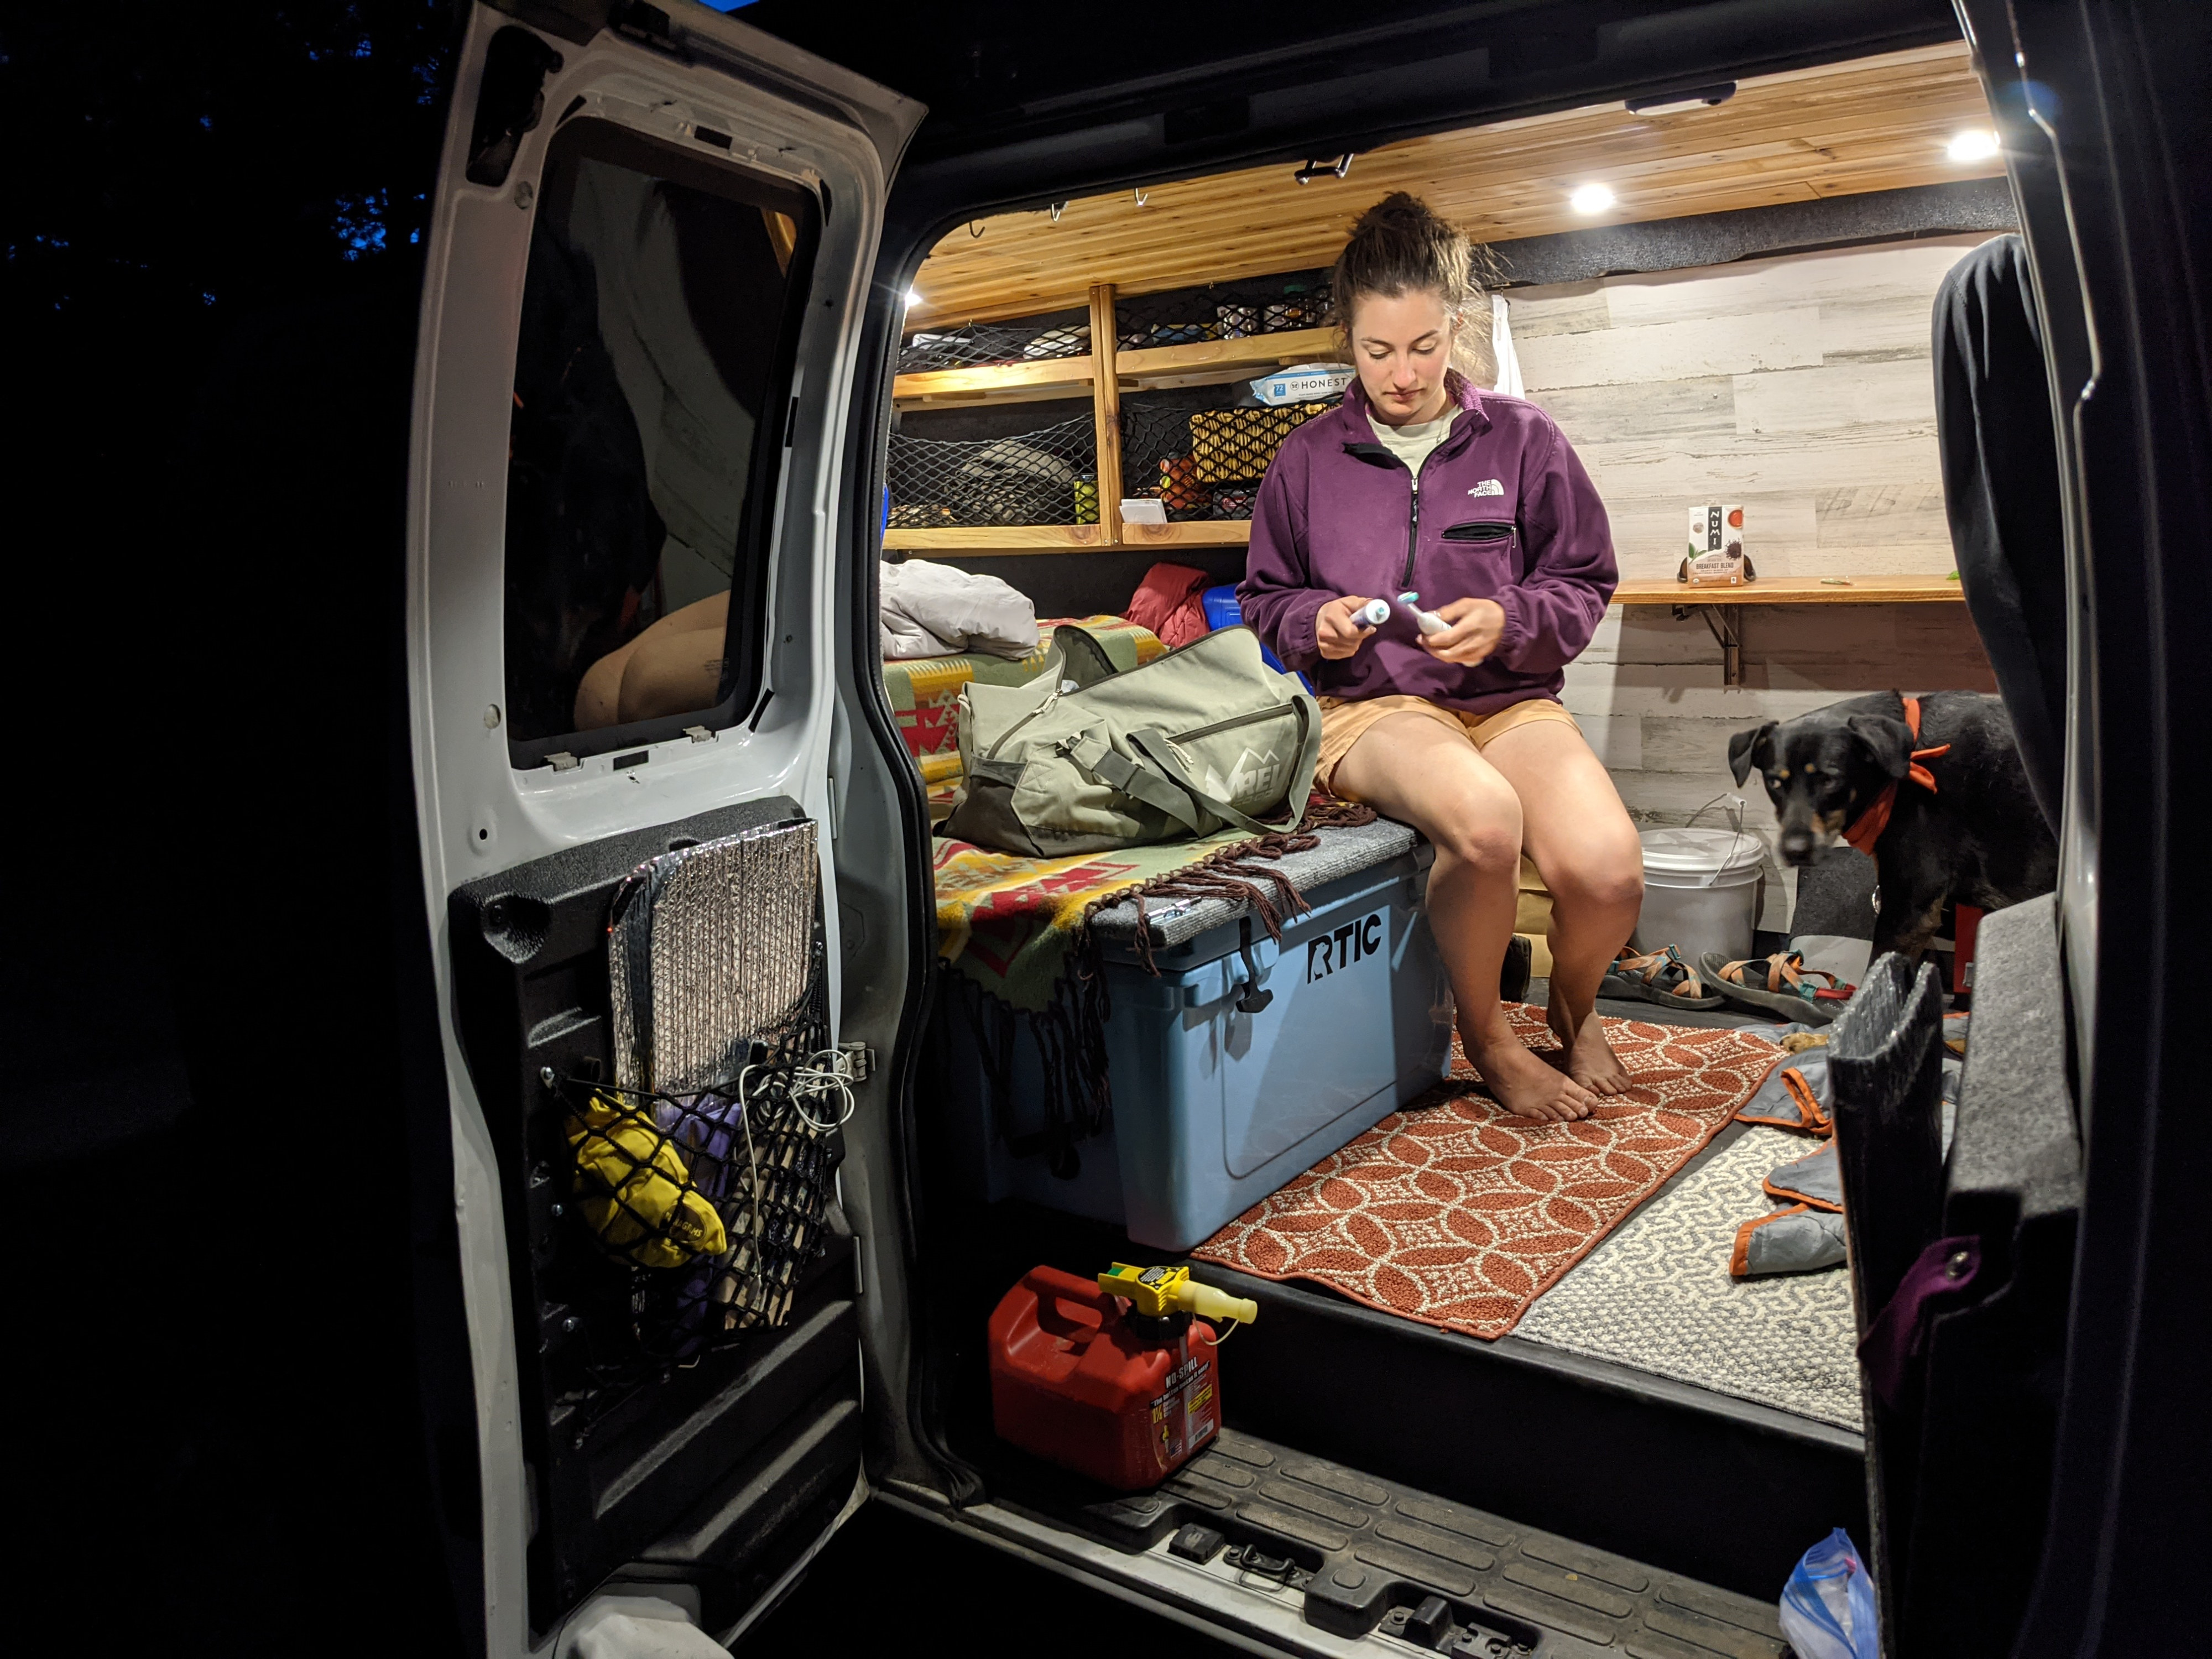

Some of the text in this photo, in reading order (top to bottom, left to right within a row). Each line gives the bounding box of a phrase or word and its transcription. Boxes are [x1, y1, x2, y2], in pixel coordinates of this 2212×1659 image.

[1301, 377, 1347, 389] HONEST
[1468, 485, 1491, 495] NORTH
[1474, 490, 1491, 498] FACE
[1710, 511, 1720, 545] NUMI
[1307, 914, 1381, 984] RTIC
[1166, 1357, 1198, 1389] NO-SPILL
